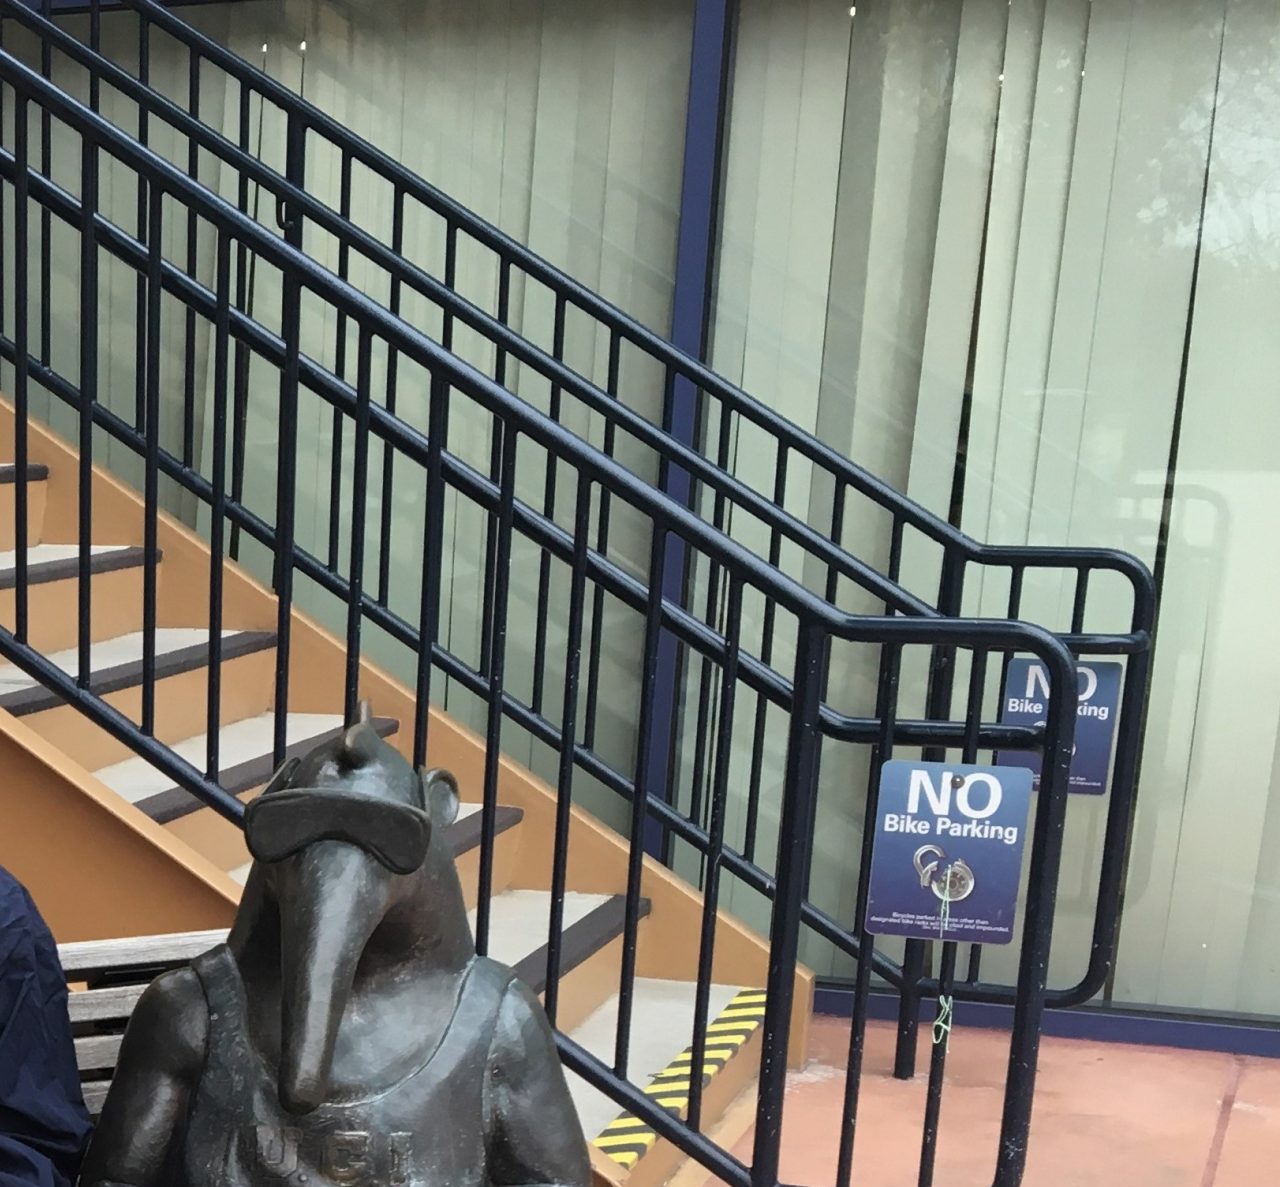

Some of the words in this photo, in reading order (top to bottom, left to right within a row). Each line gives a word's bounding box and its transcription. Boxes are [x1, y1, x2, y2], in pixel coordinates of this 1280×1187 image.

[1007, 698, 1043, 714] Bike
[907, 769, 1003, 819] NO
[884, 813, 931, 835] Bike
[936, 817, 1018, 845] Parking
